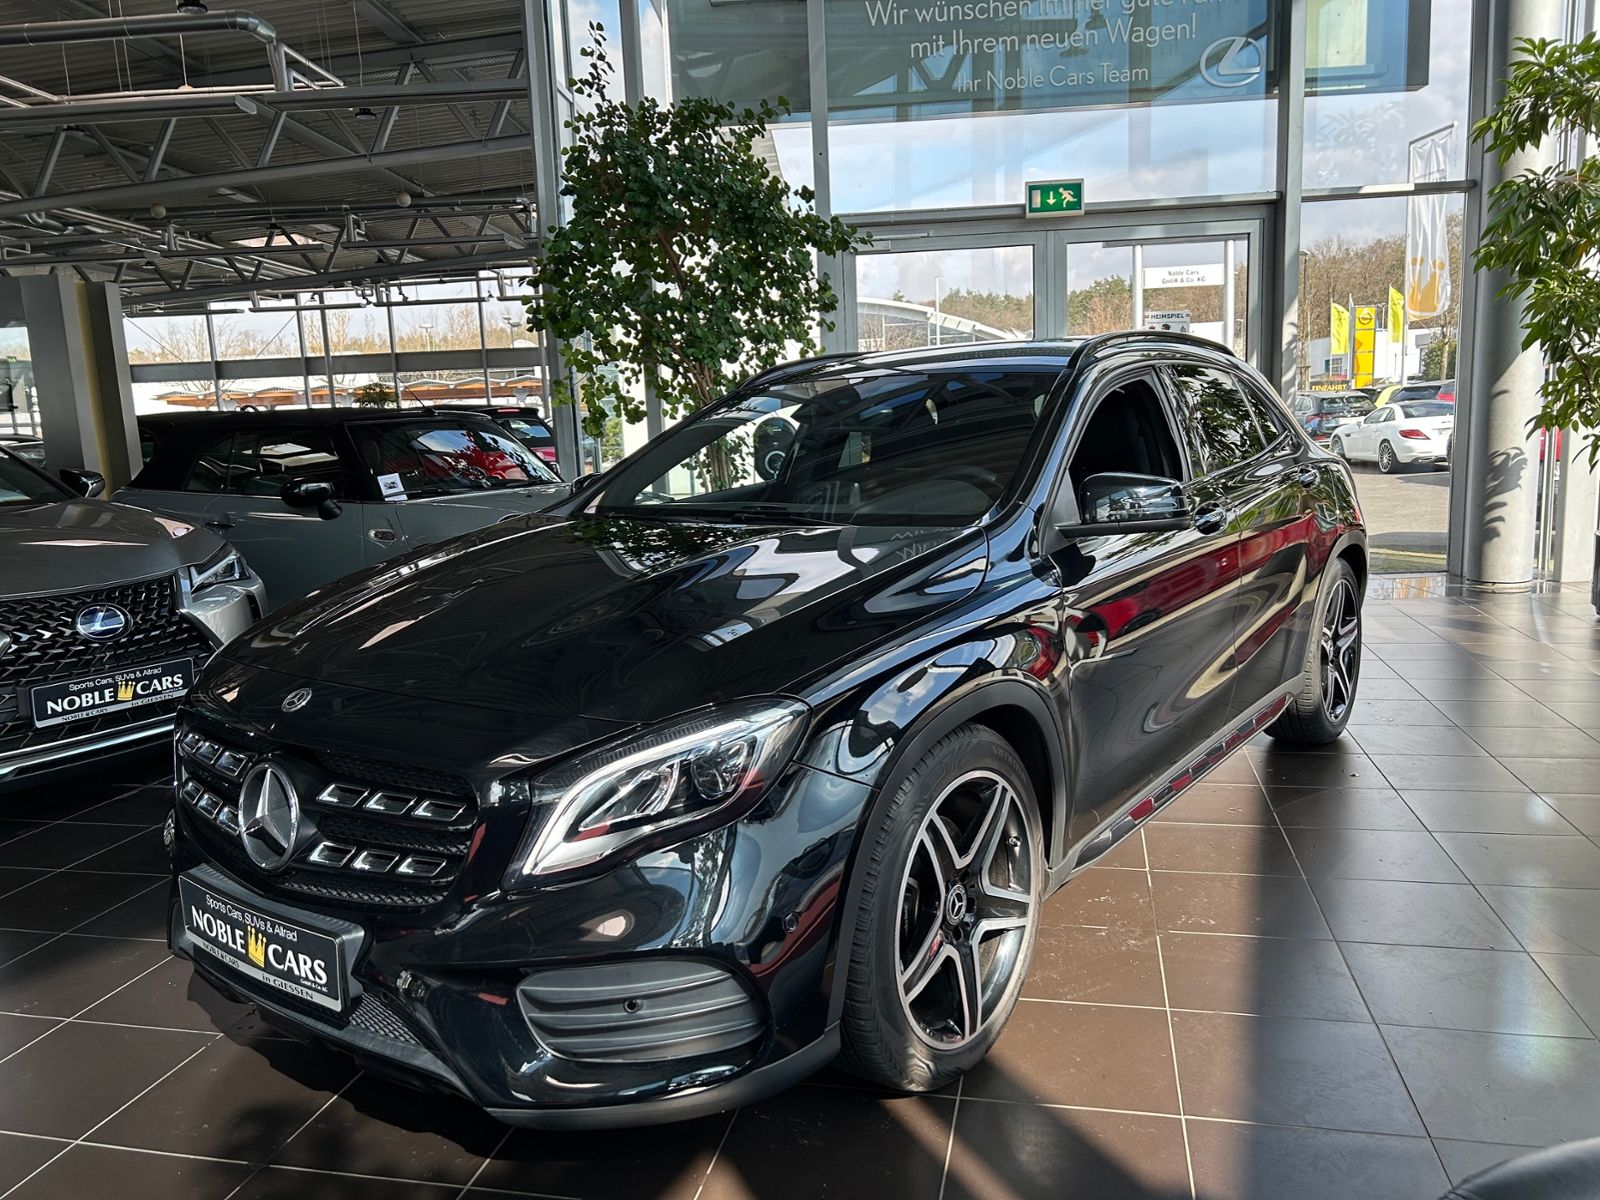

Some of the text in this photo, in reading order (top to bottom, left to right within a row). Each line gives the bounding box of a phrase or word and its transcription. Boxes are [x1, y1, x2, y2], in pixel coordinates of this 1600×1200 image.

[865, 0, 908, 26] Wir
[914, 0, 1031, 22] wünschen
[910, 12, 1197, 58] mit Ihrem neuen Wagen!
[958, 62, 1149, 92] Ihr Noble Cars Team
[46, 673, 184, 715] NOBLE CARS
[69, 680, 94, 692] Sports
[95, 676, 115, 687] Cars,
[115, 672, 135, 683] SUVs
[142, 666, 162, 676] Allrad
[205, 893, 226, 914] Sports
[244, 912, 265, 931] SUVs
[266, 921, 273, 934] &
[273, 924, 298, 942] Allrad
[191, 905, 328, 985] NOBLE CARS
[262, 973, 271, 983] in
[273, 978, 315, 1000] GIESSEN
